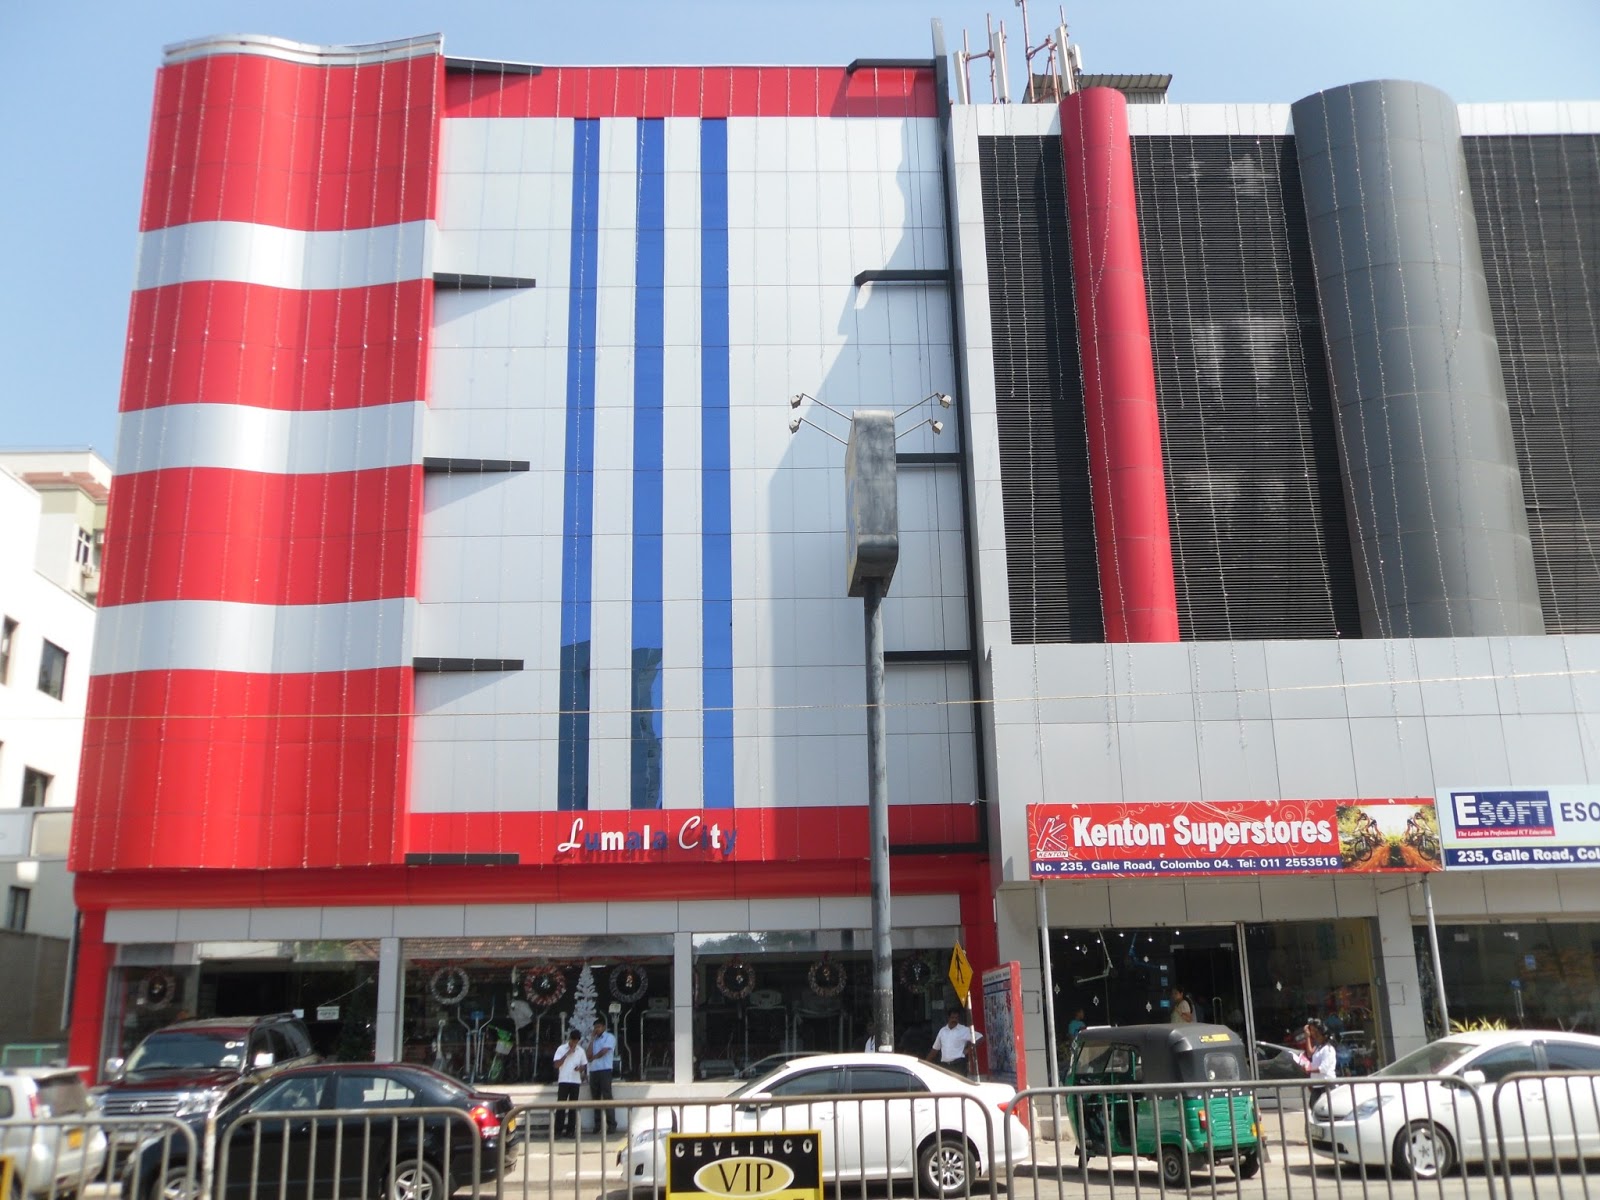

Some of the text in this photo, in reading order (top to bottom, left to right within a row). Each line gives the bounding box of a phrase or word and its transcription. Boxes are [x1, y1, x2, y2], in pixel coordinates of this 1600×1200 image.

[1455, 795, 1548, 825] ESOFT
[557, 815, 737, 855] Lumala City
[1073, 814, 1333, 852] Kenton Superstores
[1035, 857, 1338, 872] No. 235, Galle Road, Colombo 04. Tel: 011 2553516
[1457, 850, 1489, 864] 235,
[1492, 849, 1530, 862] Galle
[1533, 848, 1574, 862] Road,
[675, 1138, 813, 1158] CEYLINCO
[718, 1162, 774, 1193] VIP
